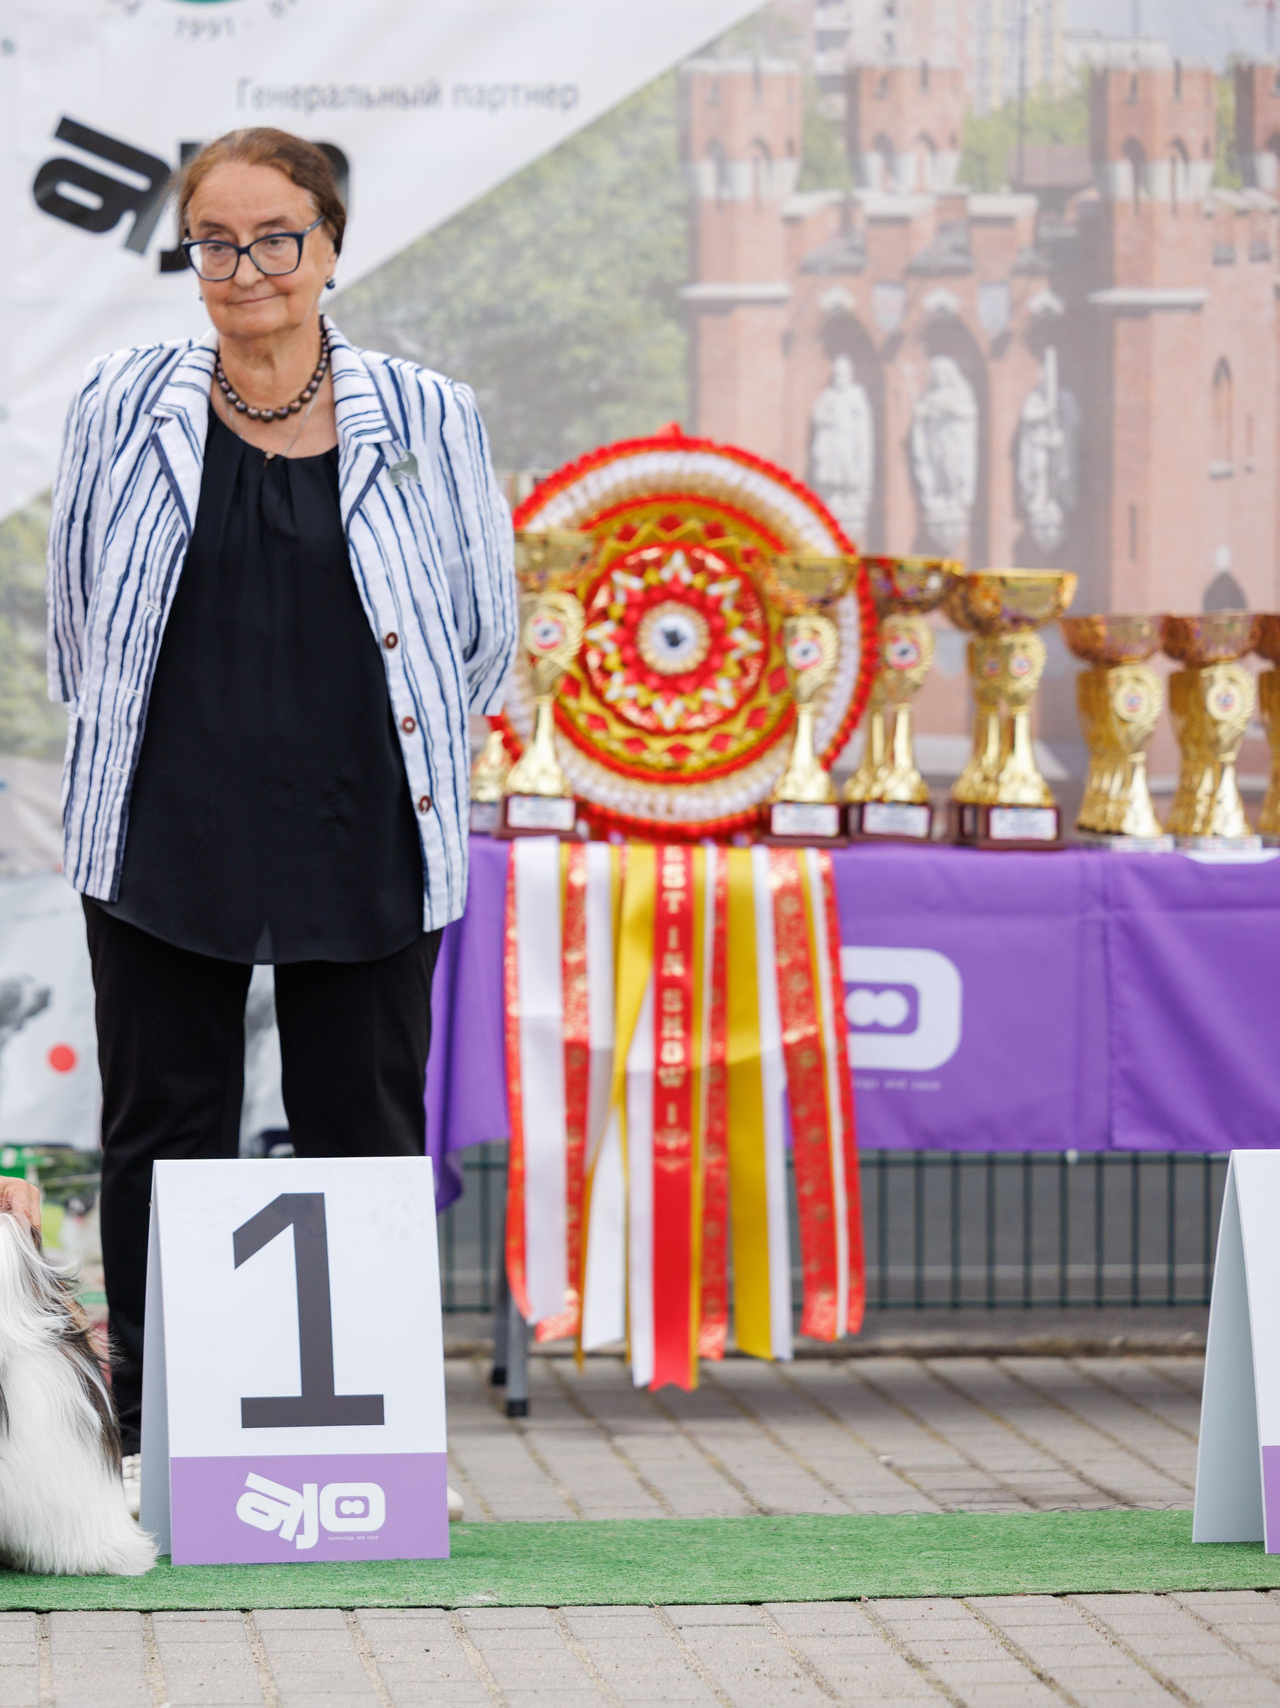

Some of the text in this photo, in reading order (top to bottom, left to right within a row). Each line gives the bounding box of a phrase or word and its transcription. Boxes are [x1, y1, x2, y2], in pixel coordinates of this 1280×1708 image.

[237, 78, 581, 117] Генеральный партнер
[232, 1192, 385, 1429] 1
